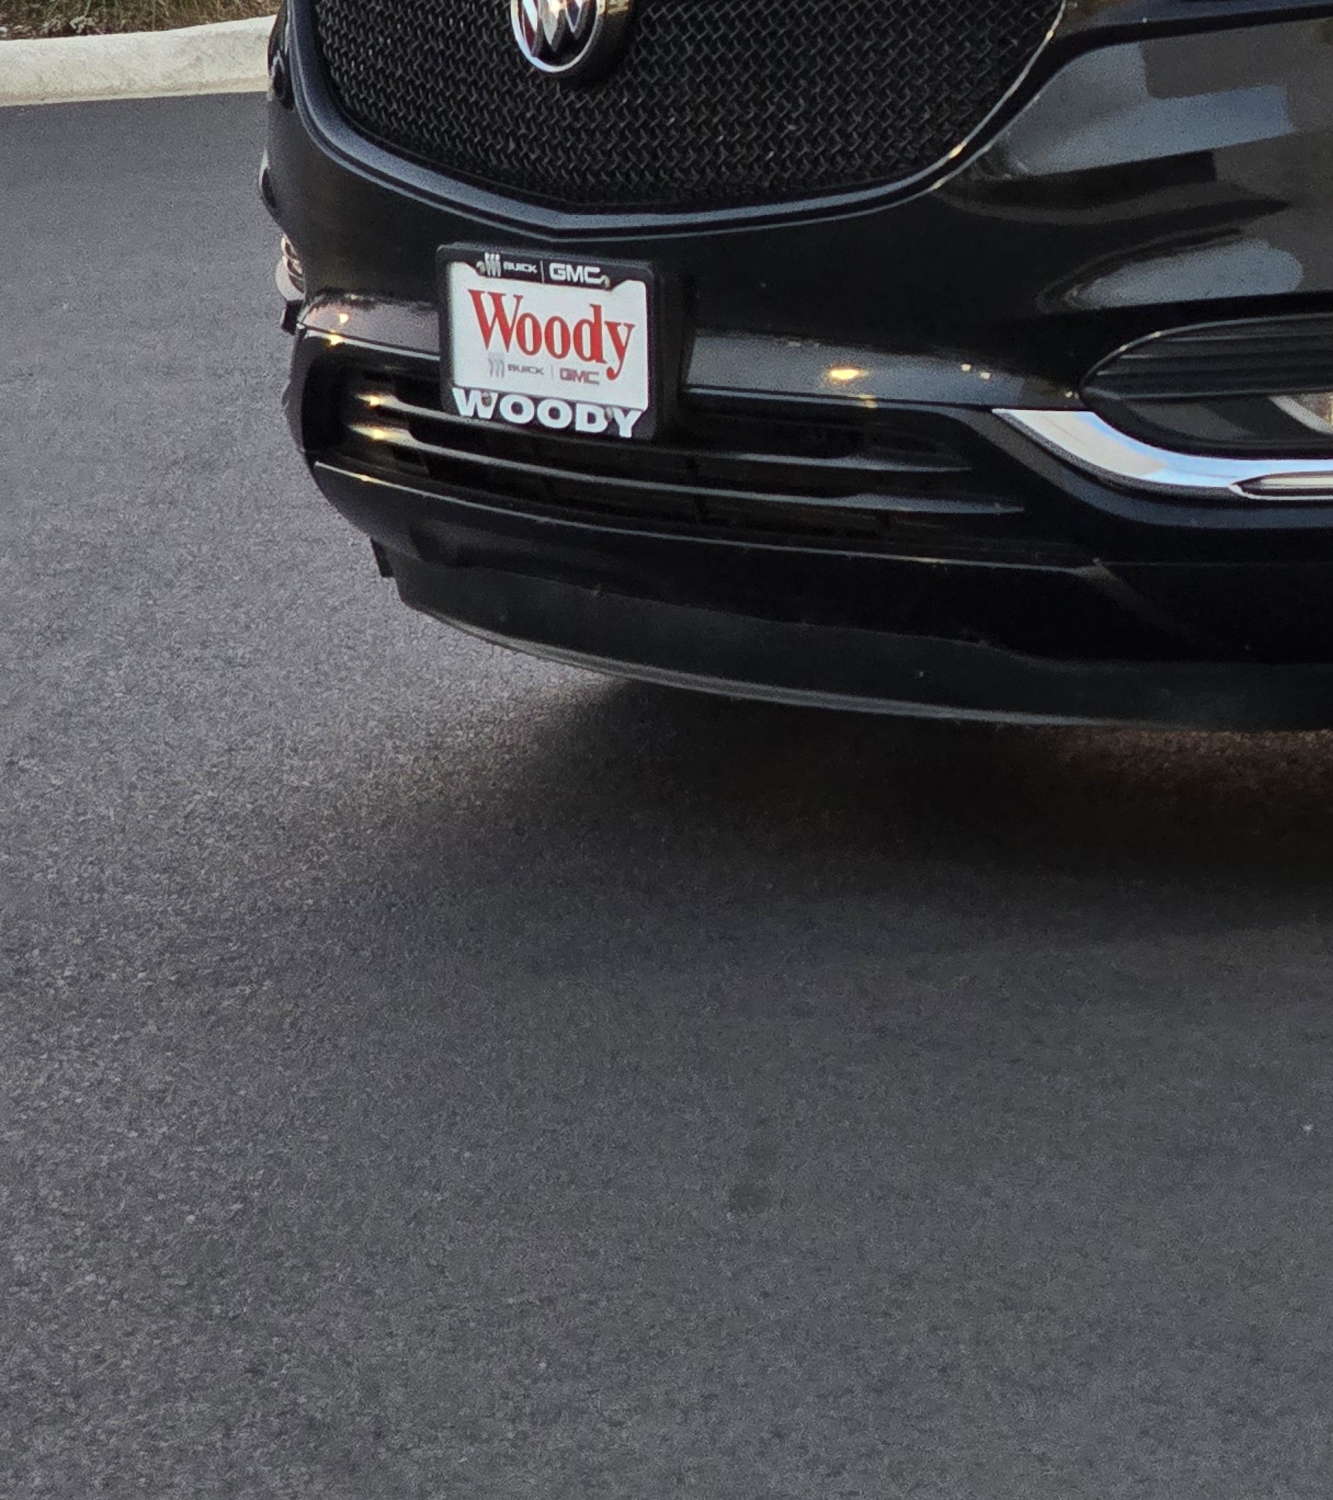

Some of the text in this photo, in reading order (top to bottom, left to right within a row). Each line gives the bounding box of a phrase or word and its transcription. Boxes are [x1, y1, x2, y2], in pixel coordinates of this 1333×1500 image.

[503, 261, 601, 284] BUICK GMC
[467, 288, 635, 381] Woody
[508, 363, 600, 385] BUICK GMC
[452, 387, 645, 439] WOODY
